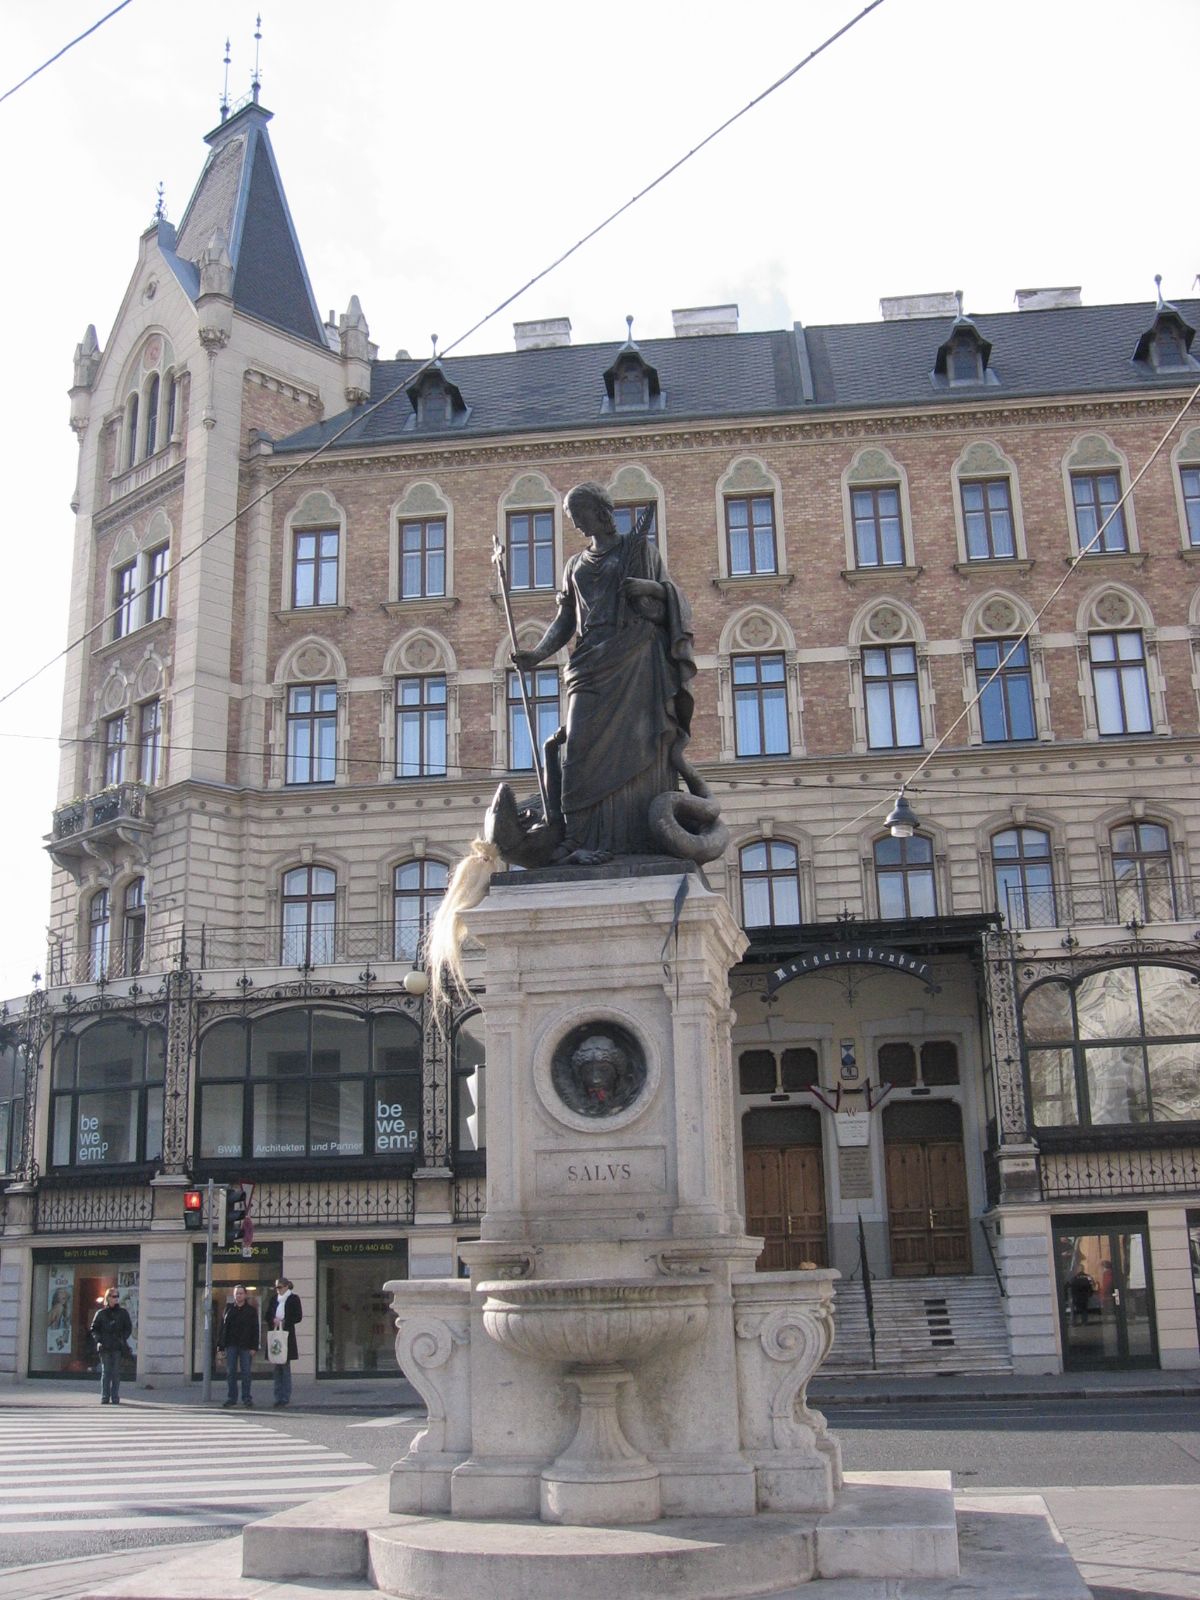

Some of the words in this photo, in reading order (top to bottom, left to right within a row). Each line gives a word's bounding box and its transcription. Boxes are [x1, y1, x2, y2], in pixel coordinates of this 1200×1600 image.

[377, 1100, 402, 1118] be
[81, 1114, 99, 1130] be
[377, 1119, 405, 1133] we
[80, 1132, 100, 1145] we
[217, 1144, 241, 1154] BWM
[255, 1143, 305, 1153] Architekten
[311, 1142, 328, 1151] und
[330, 1141, 363, 1151] Partner
[567, 1163, 631, 1181] SALVS
